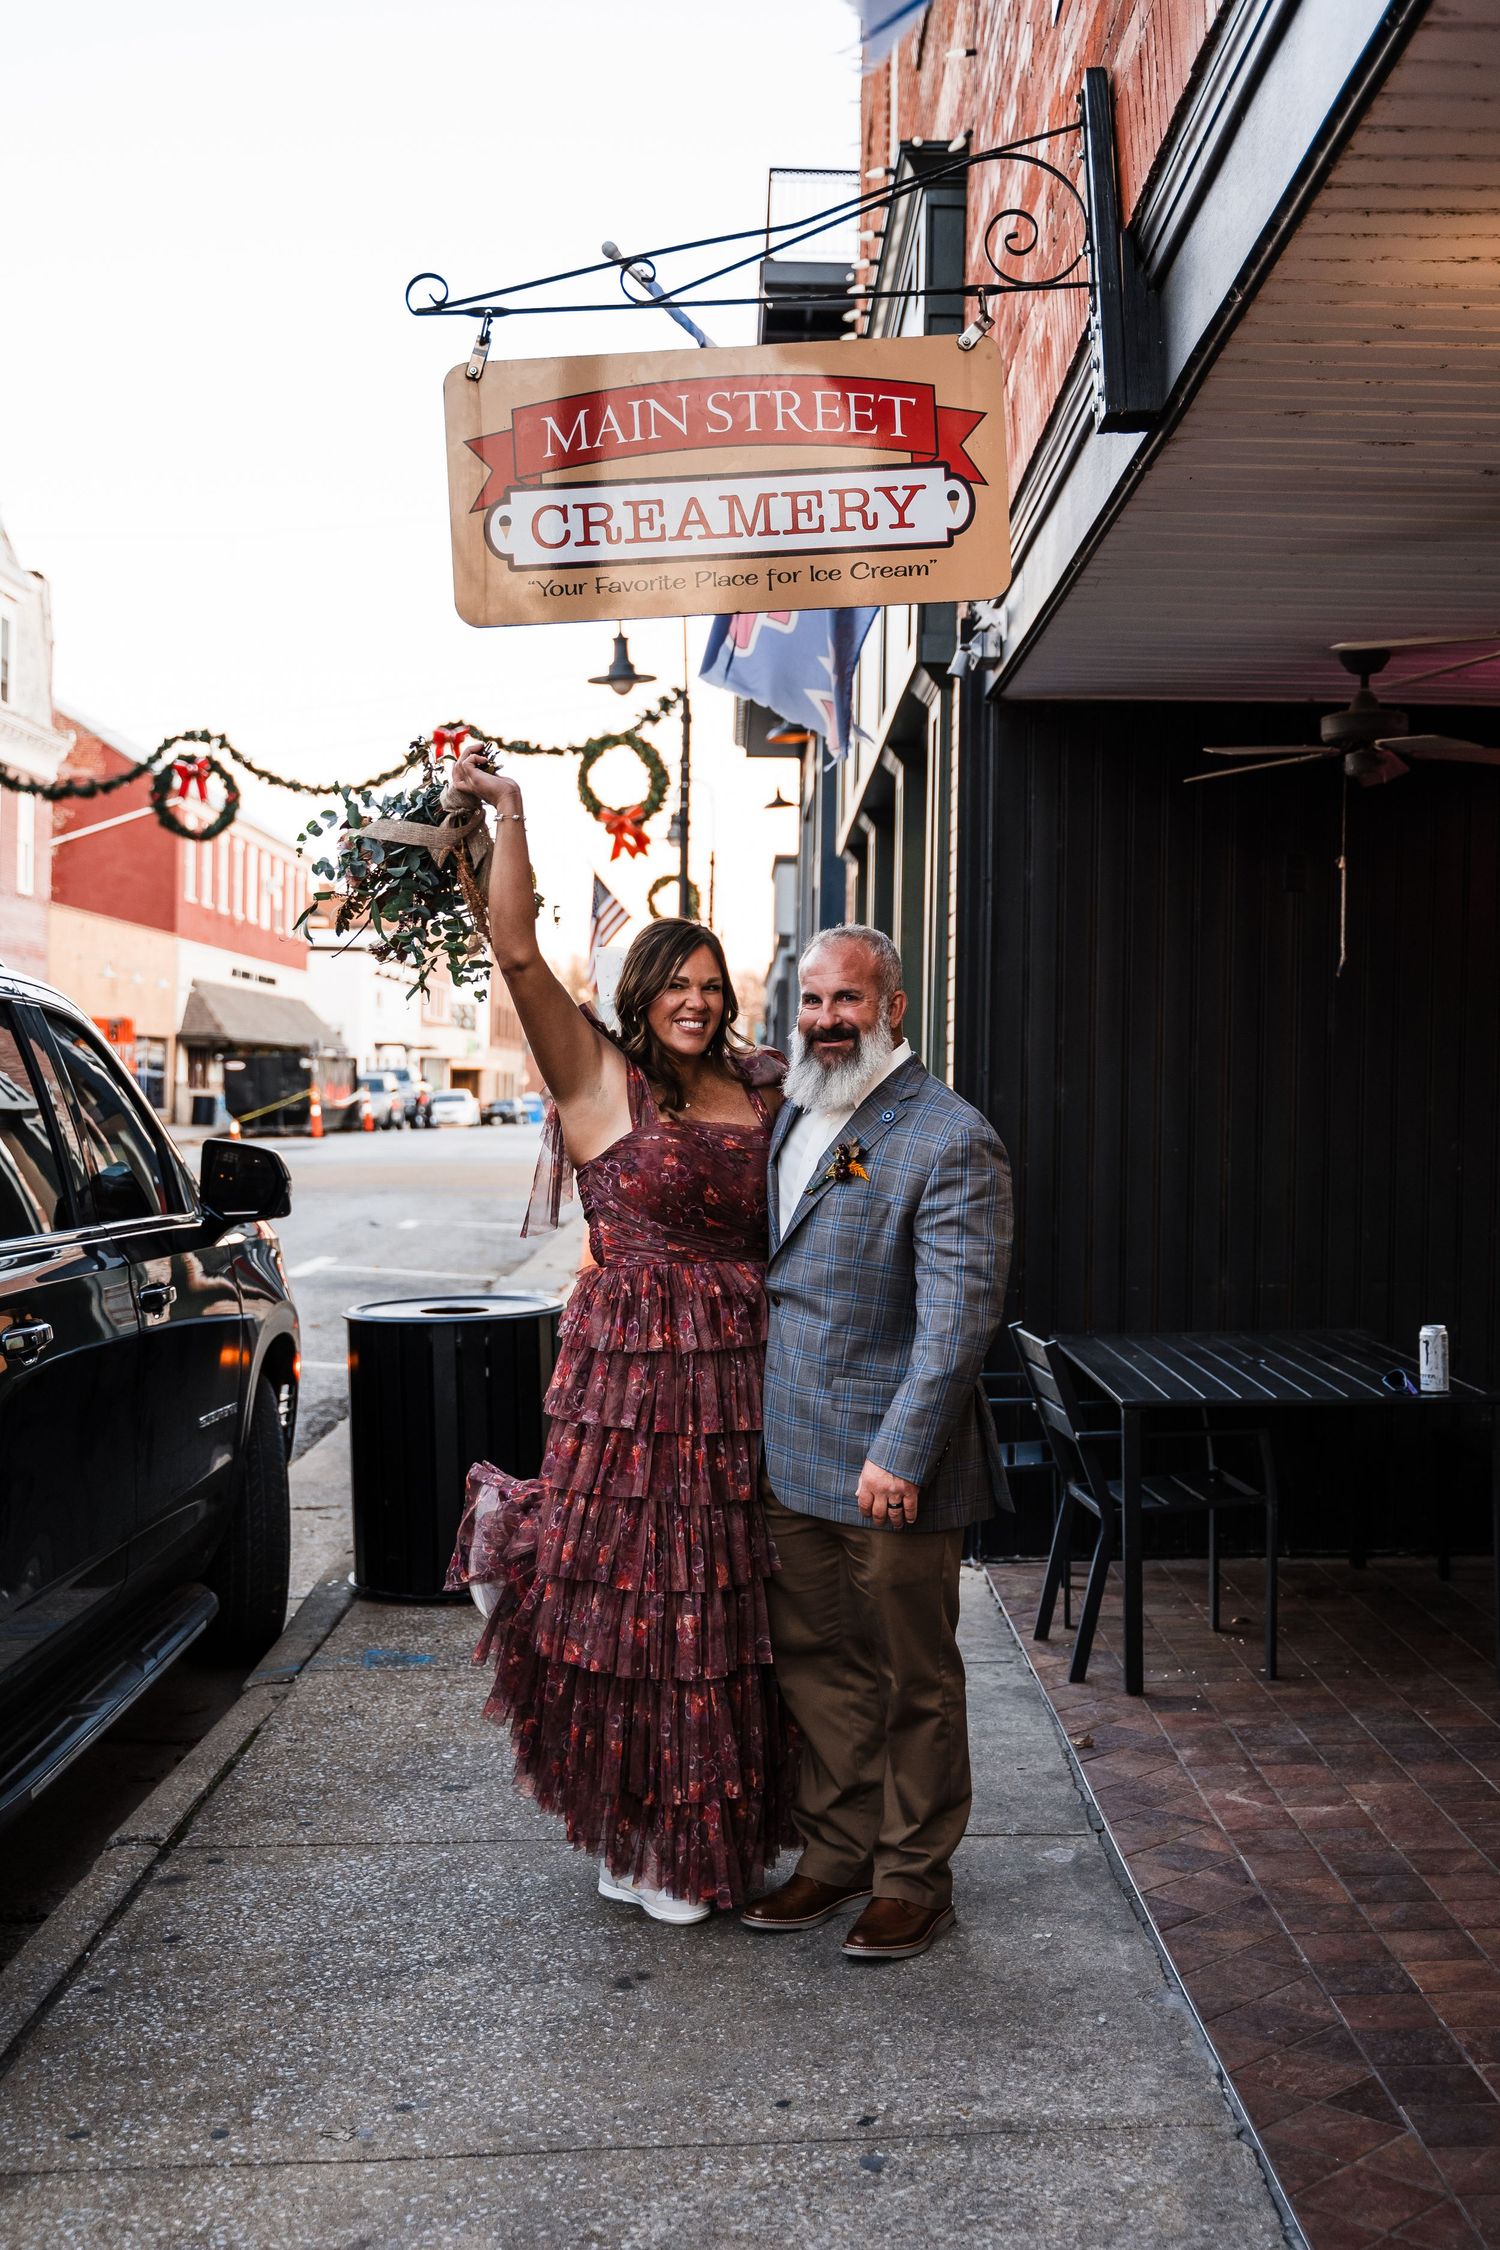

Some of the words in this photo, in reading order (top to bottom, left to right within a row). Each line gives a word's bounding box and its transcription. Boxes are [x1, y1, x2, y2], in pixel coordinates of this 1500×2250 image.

[541, 394, 689, 459] MAIN
[704, 388, 917, 436] STREET
[530, 484, 927, 549] CREAMERY
[528, 577, 588, 598] “Your
[595, 574, 687, 595] Favorite
[695, 568, 760, 591] Place
[767, 566, 803, 592] for
[810, 565, 844, 582] Ice
[850, 559, 938, 582] Cream”
